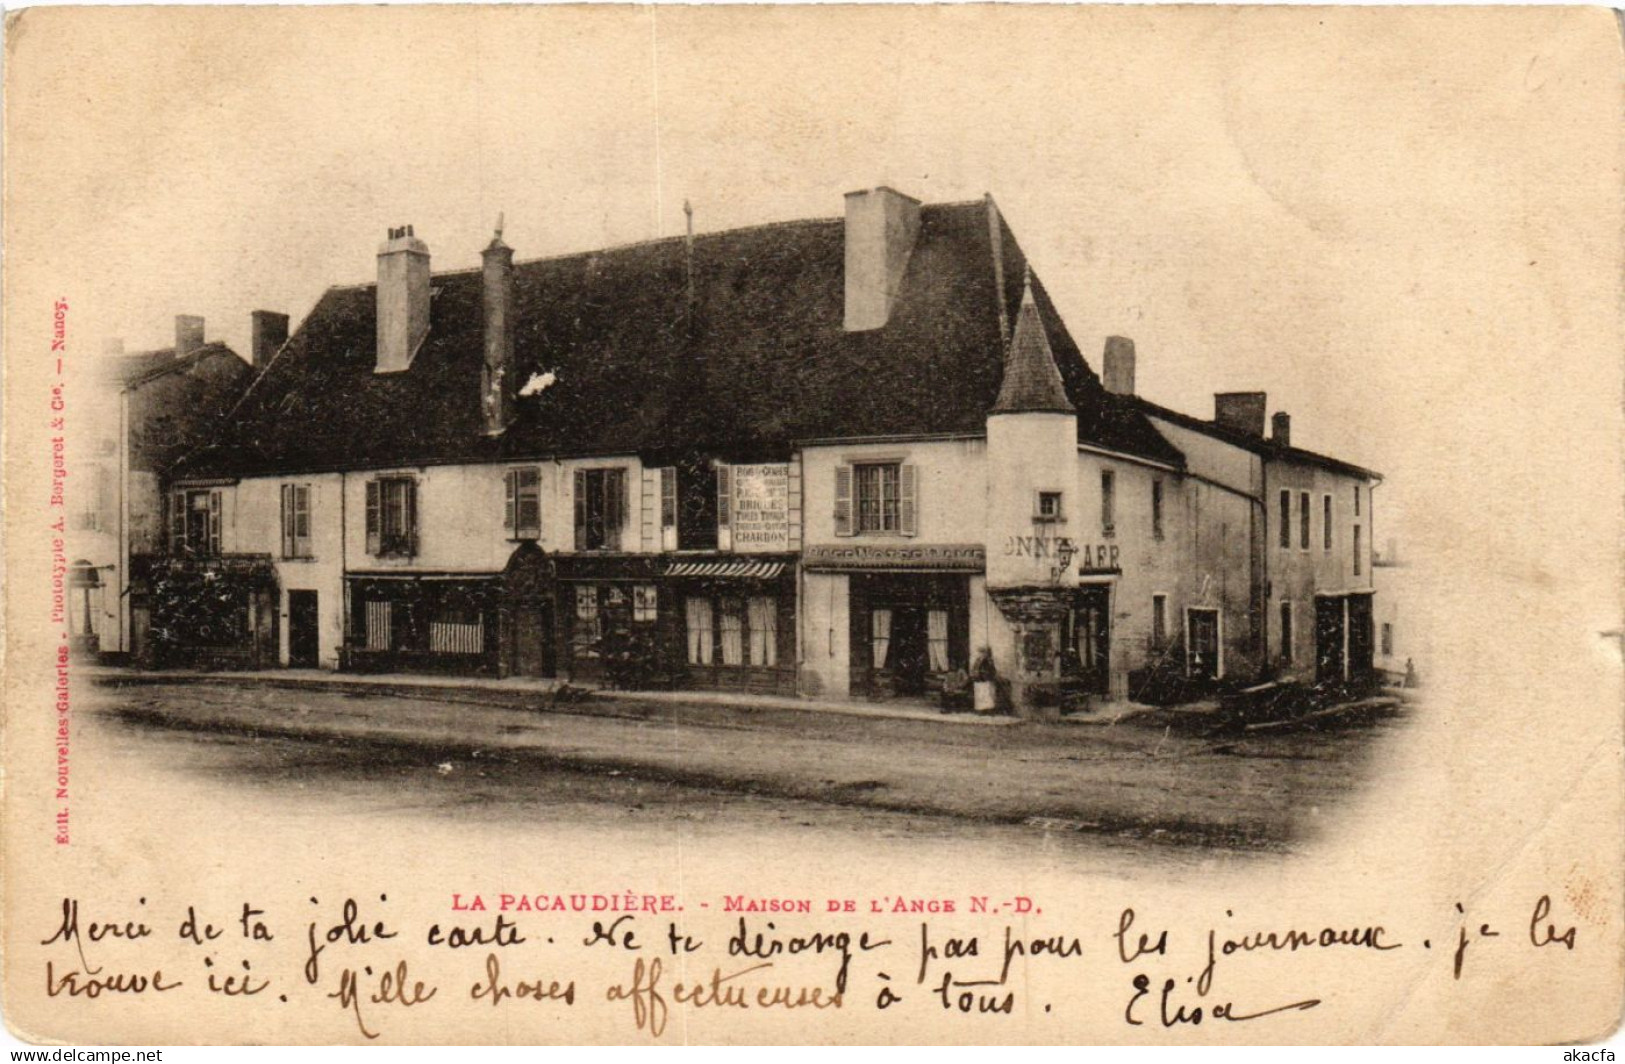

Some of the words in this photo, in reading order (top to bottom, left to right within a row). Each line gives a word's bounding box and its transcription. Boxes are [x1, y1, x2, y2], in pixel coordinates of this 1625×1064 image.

[735, 531, 786, 543] CHARBON
[41, 897, 152, 975] Merci
[179, 906, 223, 945] de
[239, 902, 274, 941] ta
[304, 894, 398, 985] jolie
[583, 914, 641, 947] Ne
[728, 916, 892, 1008] dérange
[917, 922, 980, 985] pas
[1003, 926, 1082, 987] pour
[1113, 908, 1168, 963] les
[1530, 894, 1576, 950] les
[46, 961, 184, 998] trouve
[327, 959, 438, 1041] Mille
[471, 952, 576, 1007] choses
[606, 956, 844, 1038] affectueuses
[876, 972, 903, 1010] à
[1125, 973, 1322, 1028] Elisa
